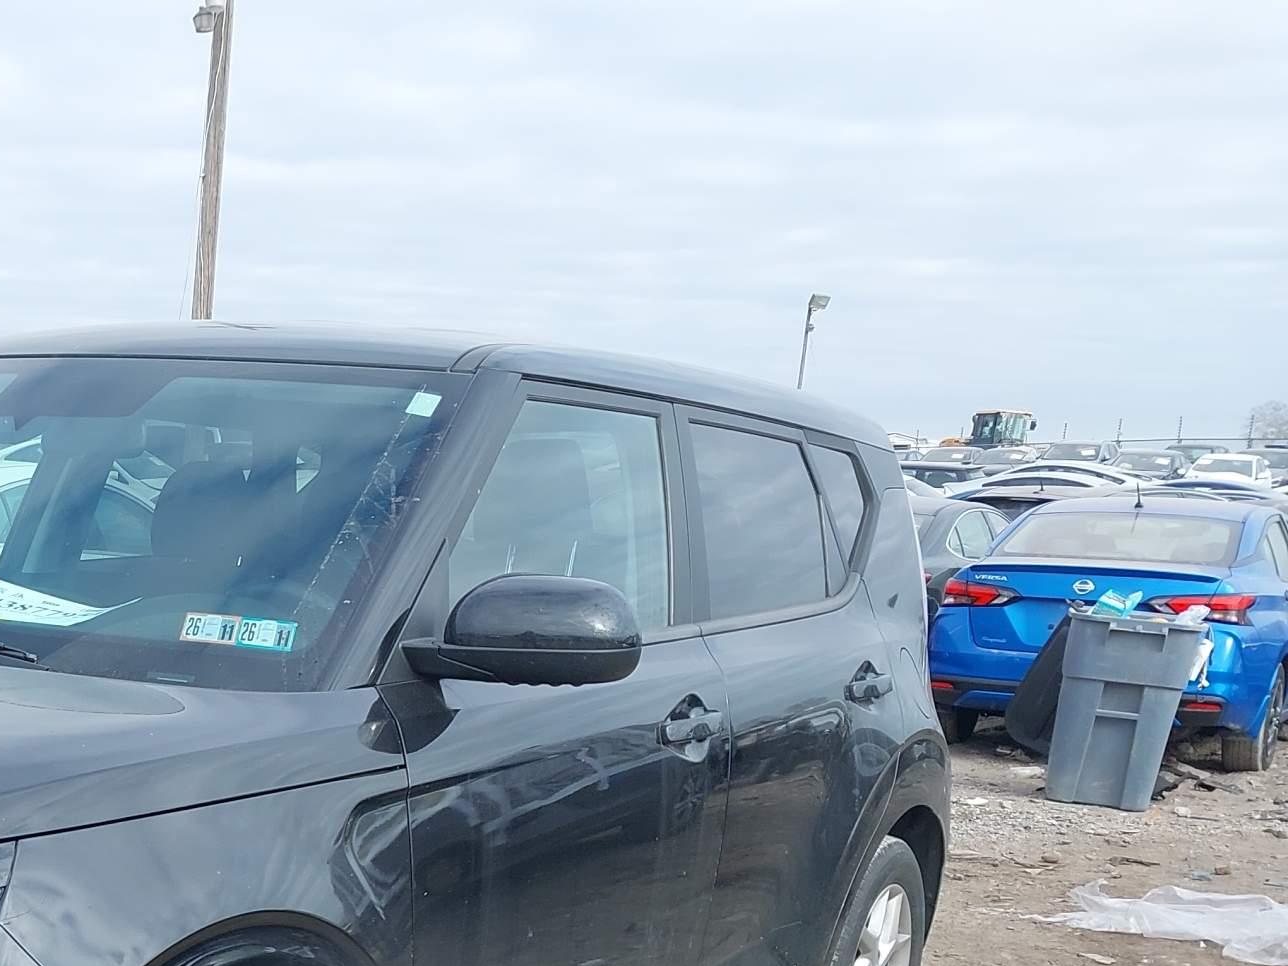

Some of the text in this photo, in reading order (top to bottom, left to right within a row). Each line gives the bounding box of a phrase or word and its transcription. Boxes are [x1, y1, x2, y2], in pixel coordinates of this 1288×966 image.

[185, 617, 235, 641] 26 11
[240, 622, 291, 647] 26 11
